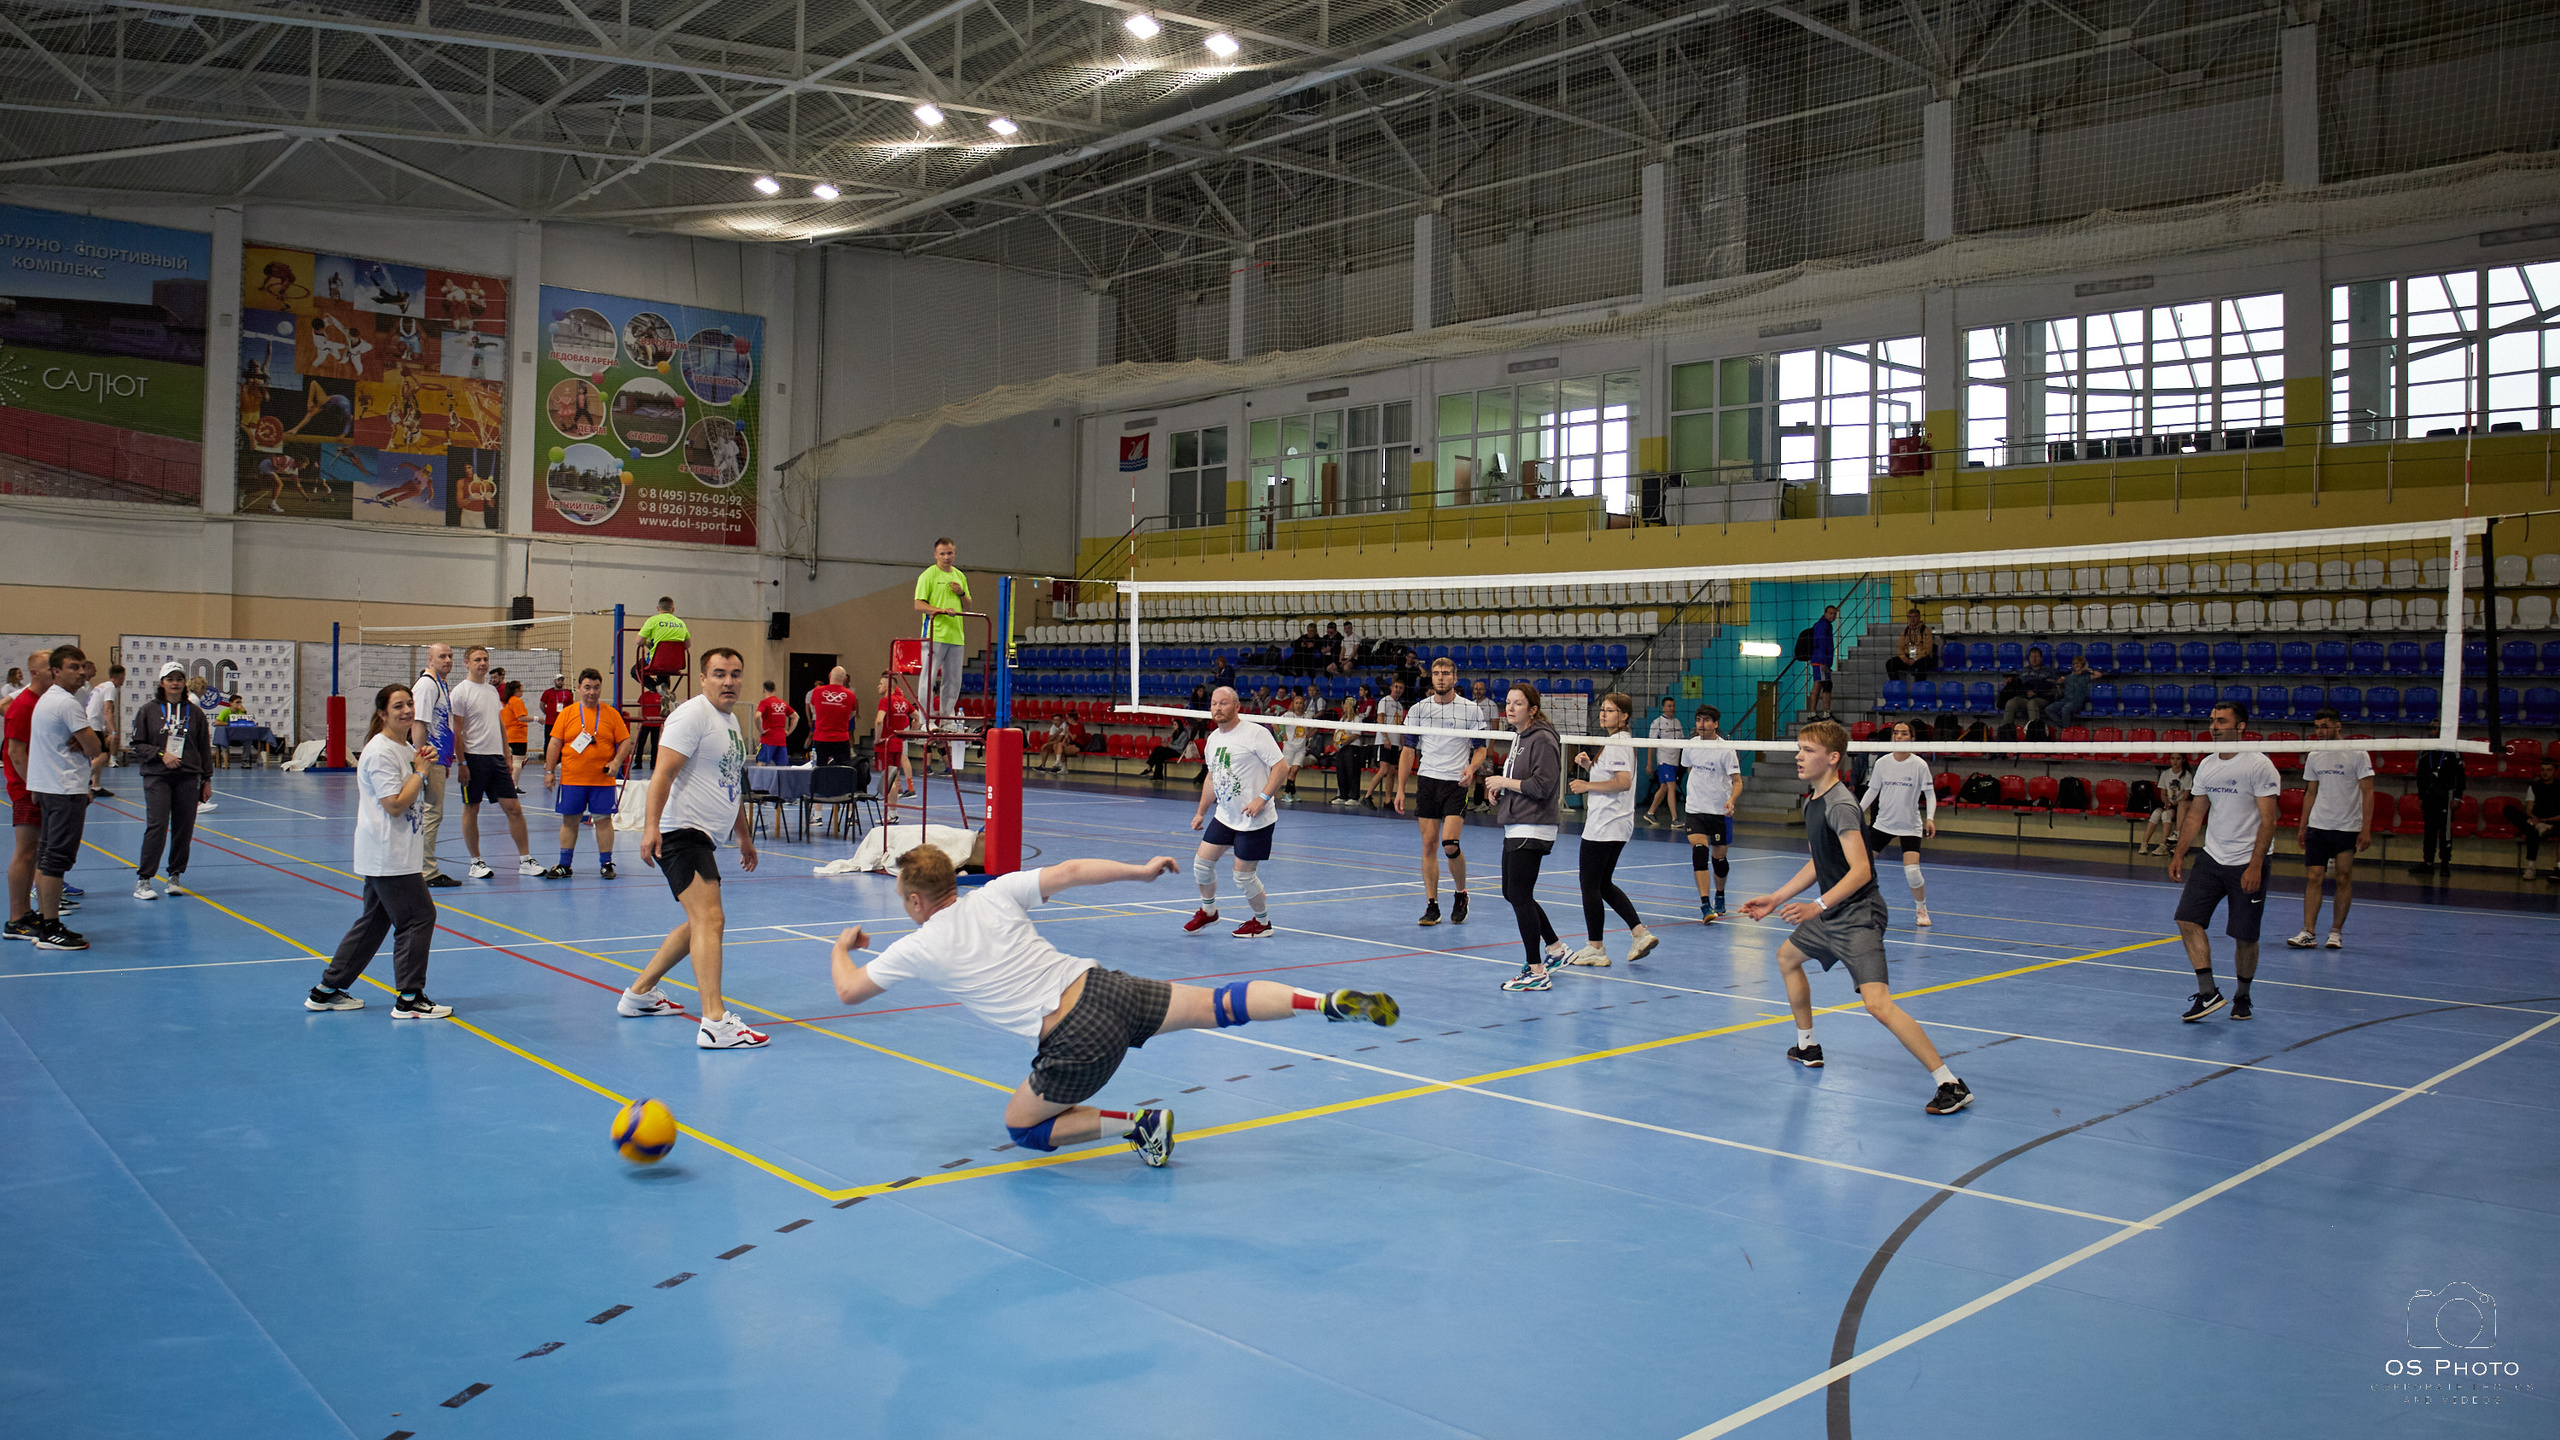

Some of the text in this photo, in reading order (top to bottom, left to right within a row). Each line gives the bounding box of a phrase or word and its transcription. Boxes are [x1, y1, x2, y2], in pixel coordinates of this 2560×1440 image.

[75, 243, 189, 271] СПОРТИВНЫЙ
[12, 256, 106, 279] КОМПЛЕКС
[641, 337, 688, 350] ВЗРОСЛЫМ
[549, 351, 619, 367] ЛЕДОВАЯ АРЕНА
[42, 367, 149, 403] САЛЮТ
[577, 424, 607, 435] ДЕТЯМ
[627, 431, 668, 443] СТАДИОН
[678, 464, 721, 476] 42 СЕКЦИИ
[649, 489, 743, 506] 8 (495) 576-02-92
[547, 500, 606, 512] ЛЕТНИЙ ПАРК
[649, 503, 742, 519] 8 (926) 789-54-45
[639, 516, 742, 532] www.dol-sport.ru
[659, 621, 683, 629] СУДЬЯ
[1715, 833, 1721, 841] 9
